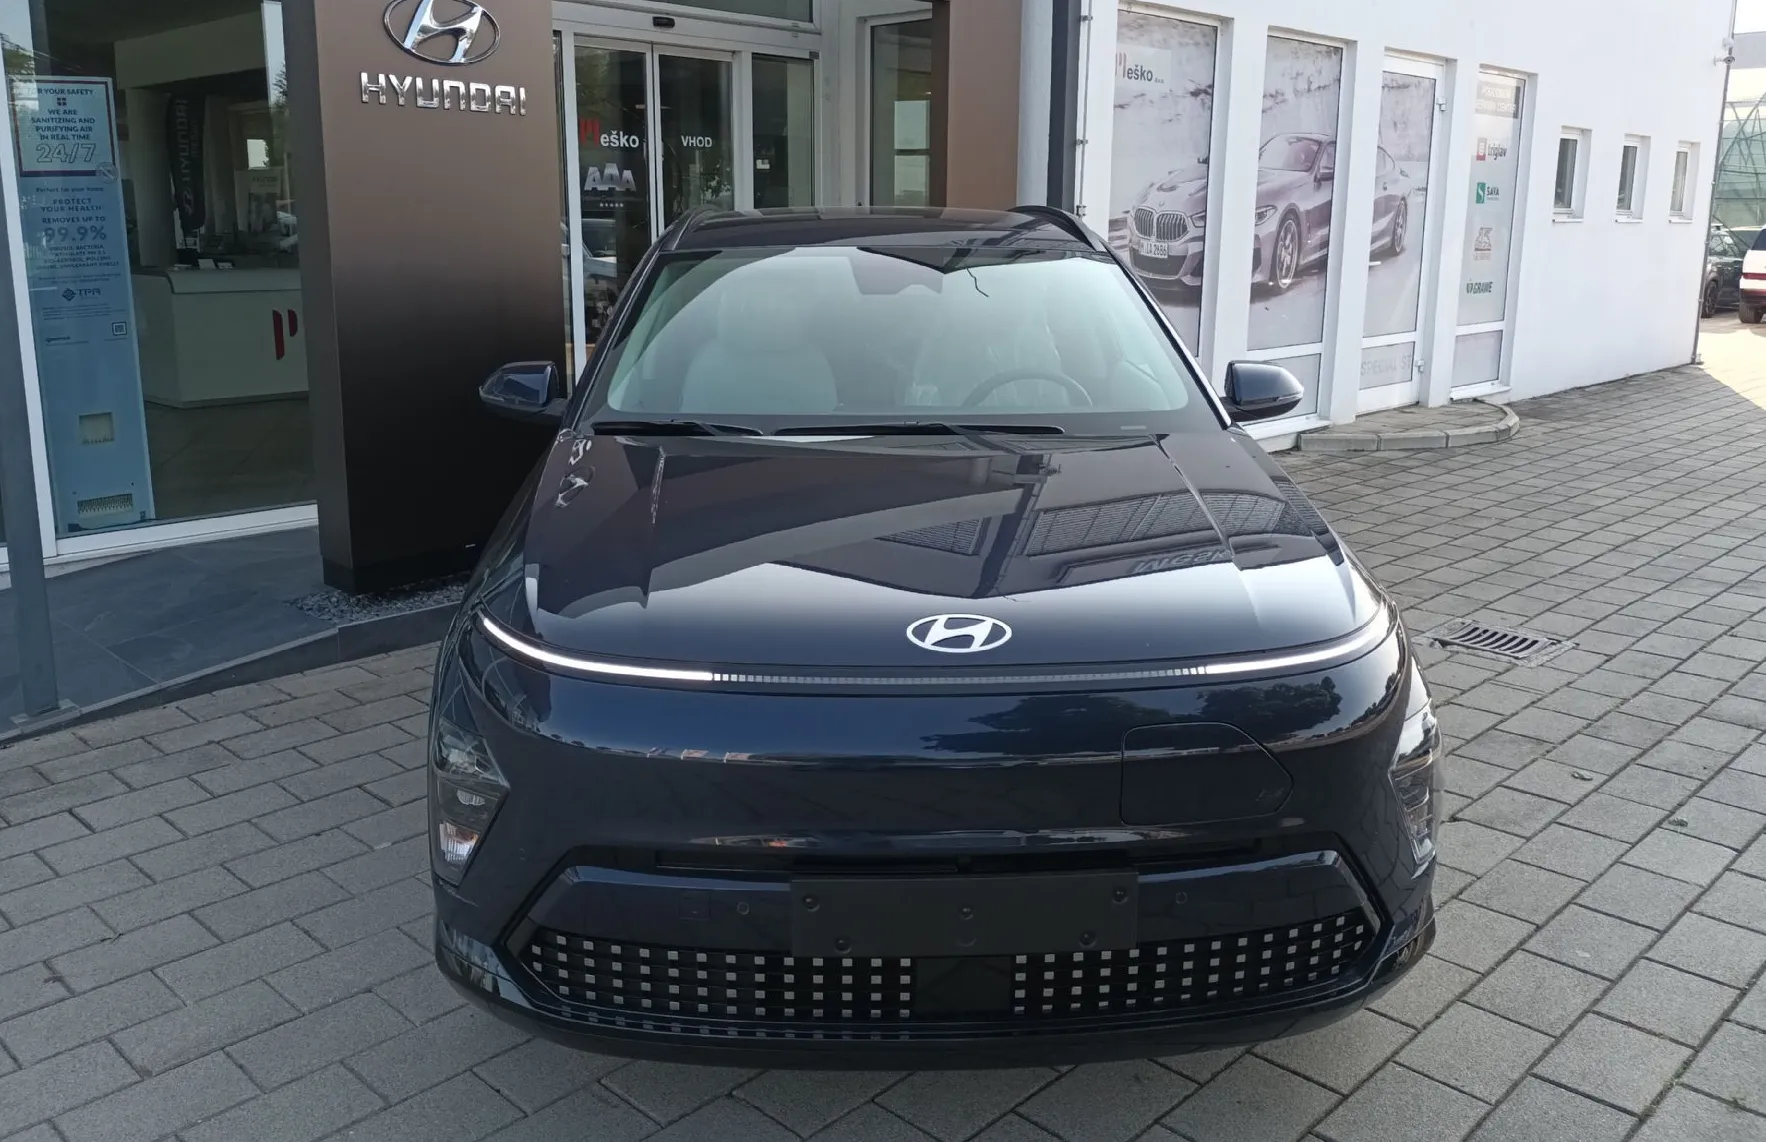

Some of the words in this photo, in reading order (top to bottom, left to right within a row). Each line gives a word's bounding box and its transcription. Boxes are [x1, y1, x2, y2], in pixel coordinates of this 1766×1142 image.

[360, 72, 527, 116] HYUNDAI
[681, 135, 713, 148] VHOD
[36, 143, 97, 164] 24/7
[44, 225, 107, 242] 99.9%
[1360, 353, 1412, 377] SPECIALST
